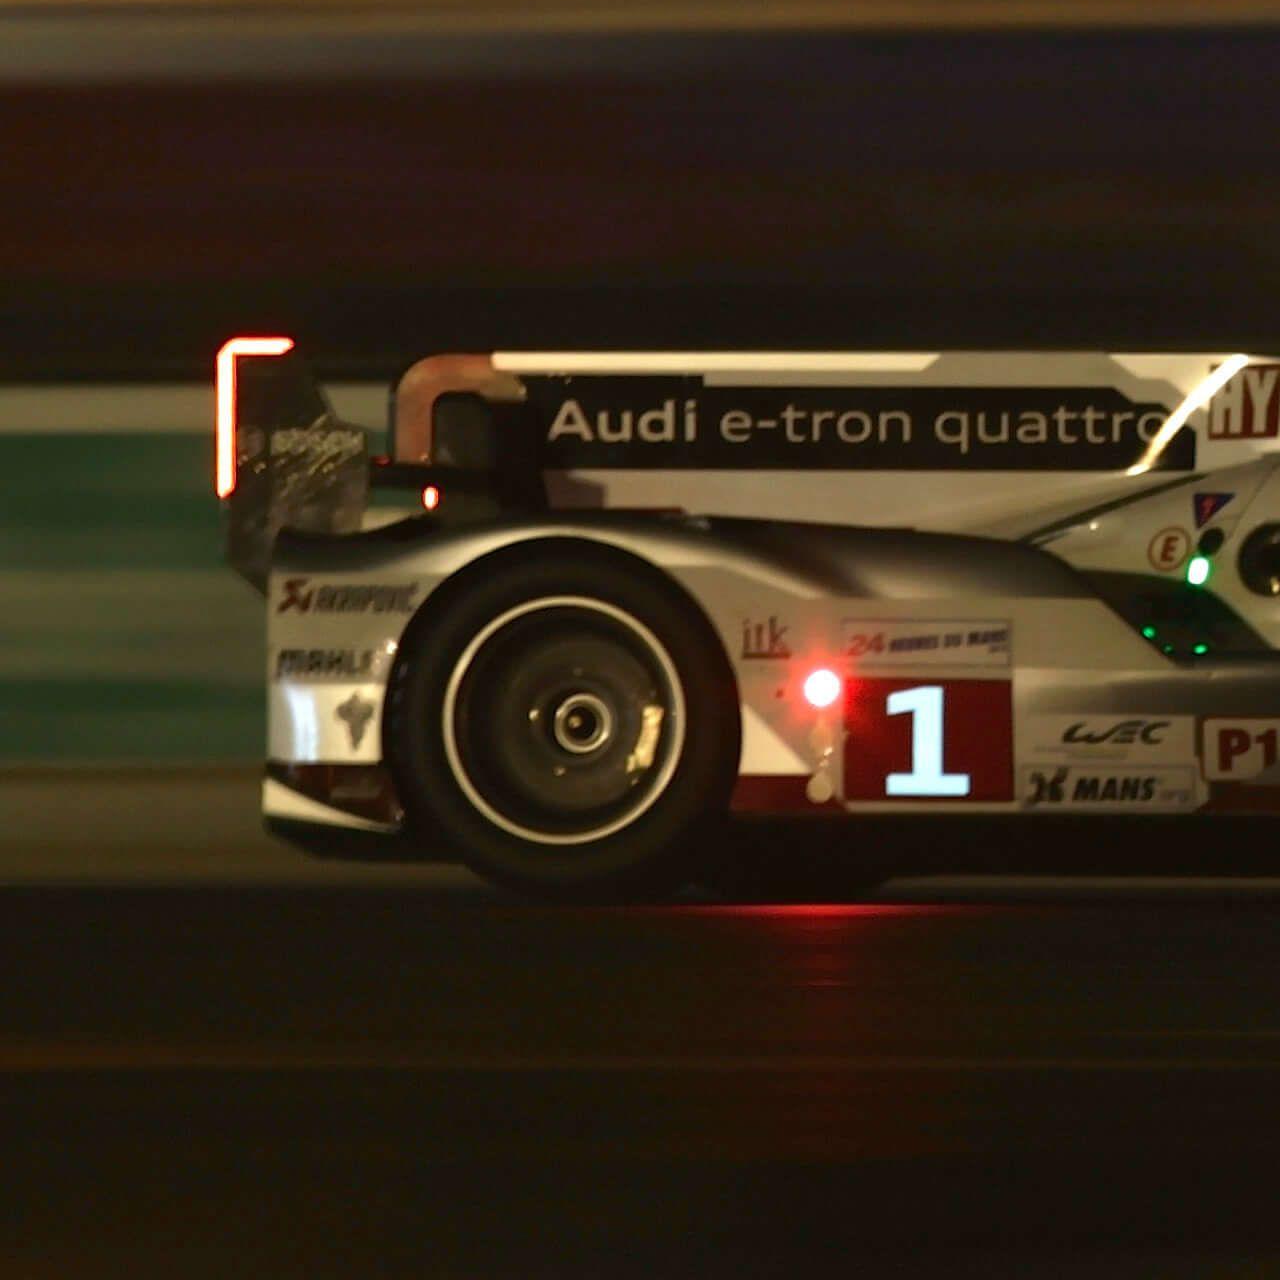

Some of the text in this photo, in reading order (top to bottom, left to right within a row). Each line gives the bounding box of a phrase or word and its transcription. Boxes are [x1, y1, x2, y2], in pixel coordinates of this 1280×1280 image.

[1211, 370, 1280, 434] HY
[548, 399, 1172, 453] Audi e-tron quattro
[1159, 535, 1179, 563] E
[847, 632, 885, 656] 24
[885, 685, 971, 798] 1
[1062, 720, 1172, 745] WEC
[1218, 728, 1278, 772] P1
[1072, 776, 1159, 802] MANS
